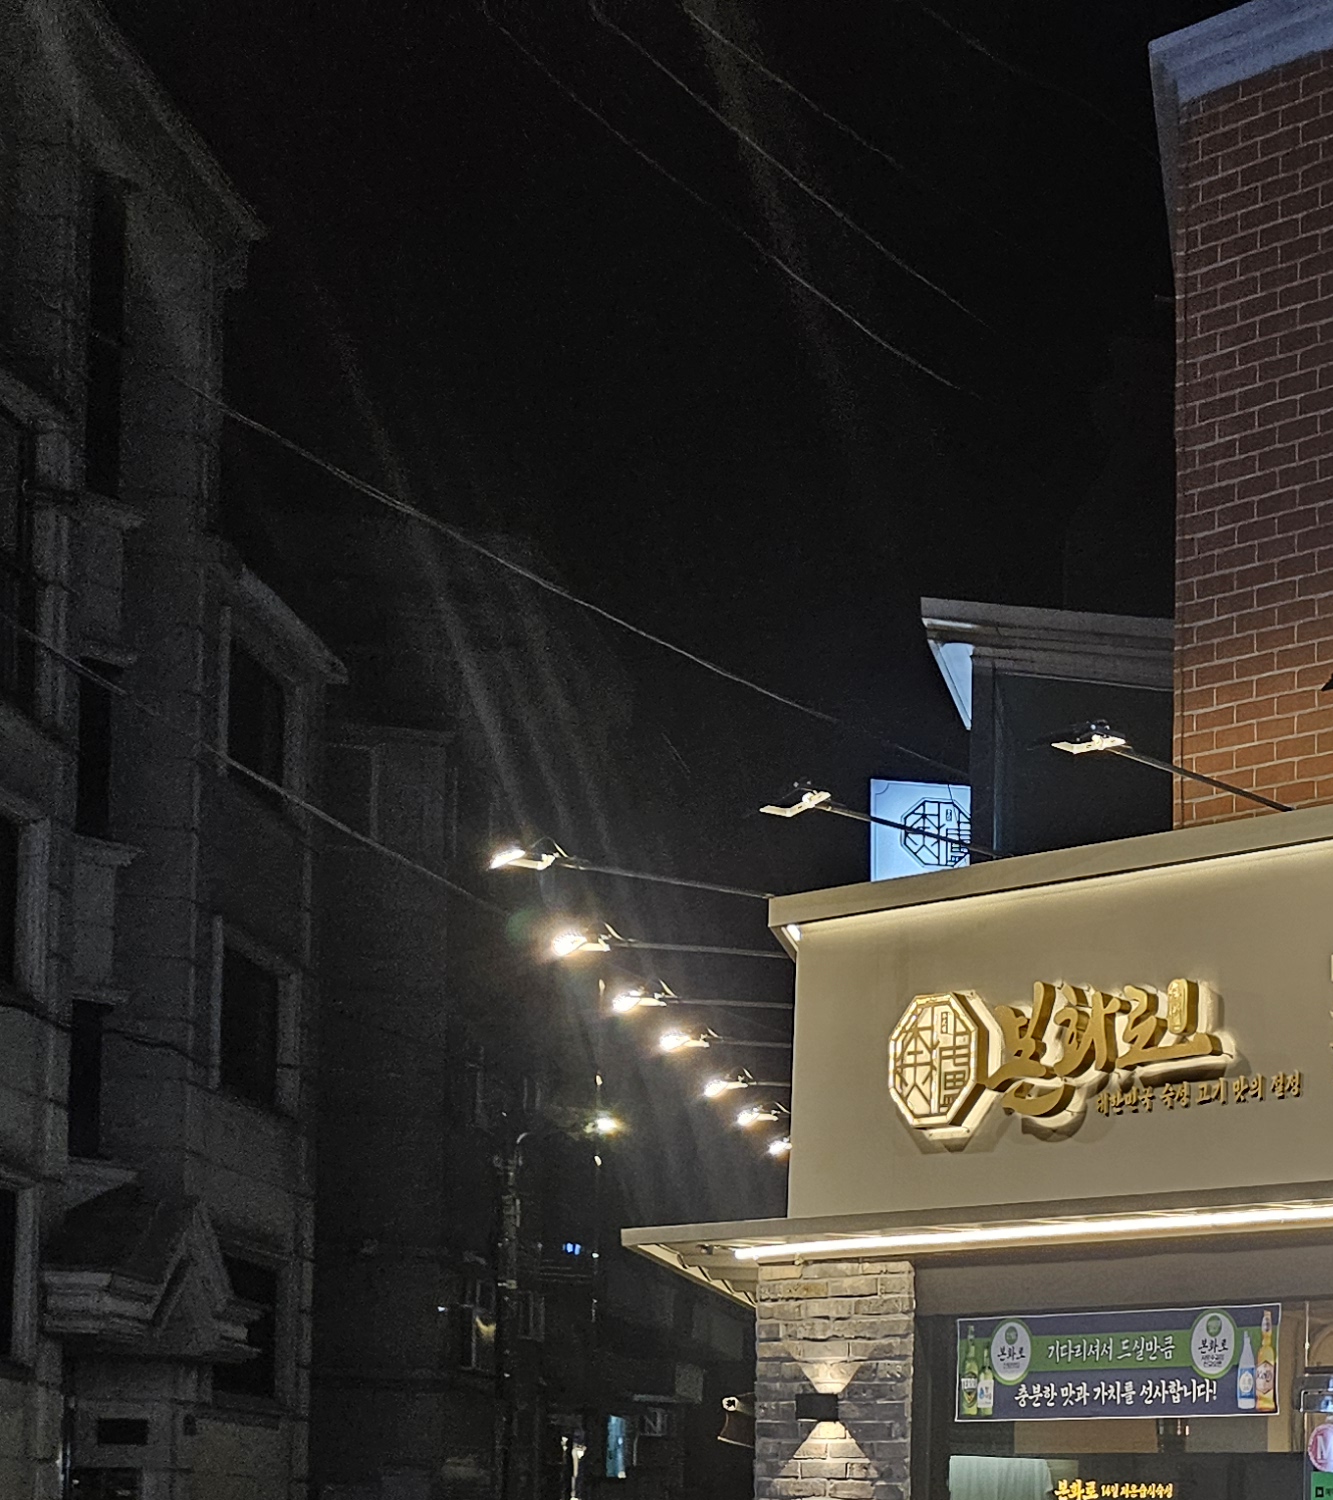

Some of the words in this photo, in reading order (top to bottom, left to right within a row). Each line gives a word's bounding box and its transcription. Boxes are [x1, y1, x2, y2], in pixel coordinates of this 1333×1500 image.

[984, 979, 1234, 1120] 본화로
[1097, 1086, 1154, 1116] 대한민국
[1159, 1081, 1190, 1109] 숙성
[1196, 1077, 1228, 1105] 고기
[1233, 1075, 1264, 1102] 맛의
[1270, 1070, 1301, 1098] 절정
[997, 1347, 1026, 1363] 본화로
[1048, 1337, 1114, 1364] 기다리셔서
[1117, 1336, 1176, 1361] 드실만큼
[1199, 1339, 1228, 1355] 본화로
[1015, 1383, 1058, 1408] 충분한
[1061, 1382, 1090, 1408] 맛과
[1093, 1381, 1135, 1406] 가치를
[1139, 1378, 1217, 1404] 선사합니다!
